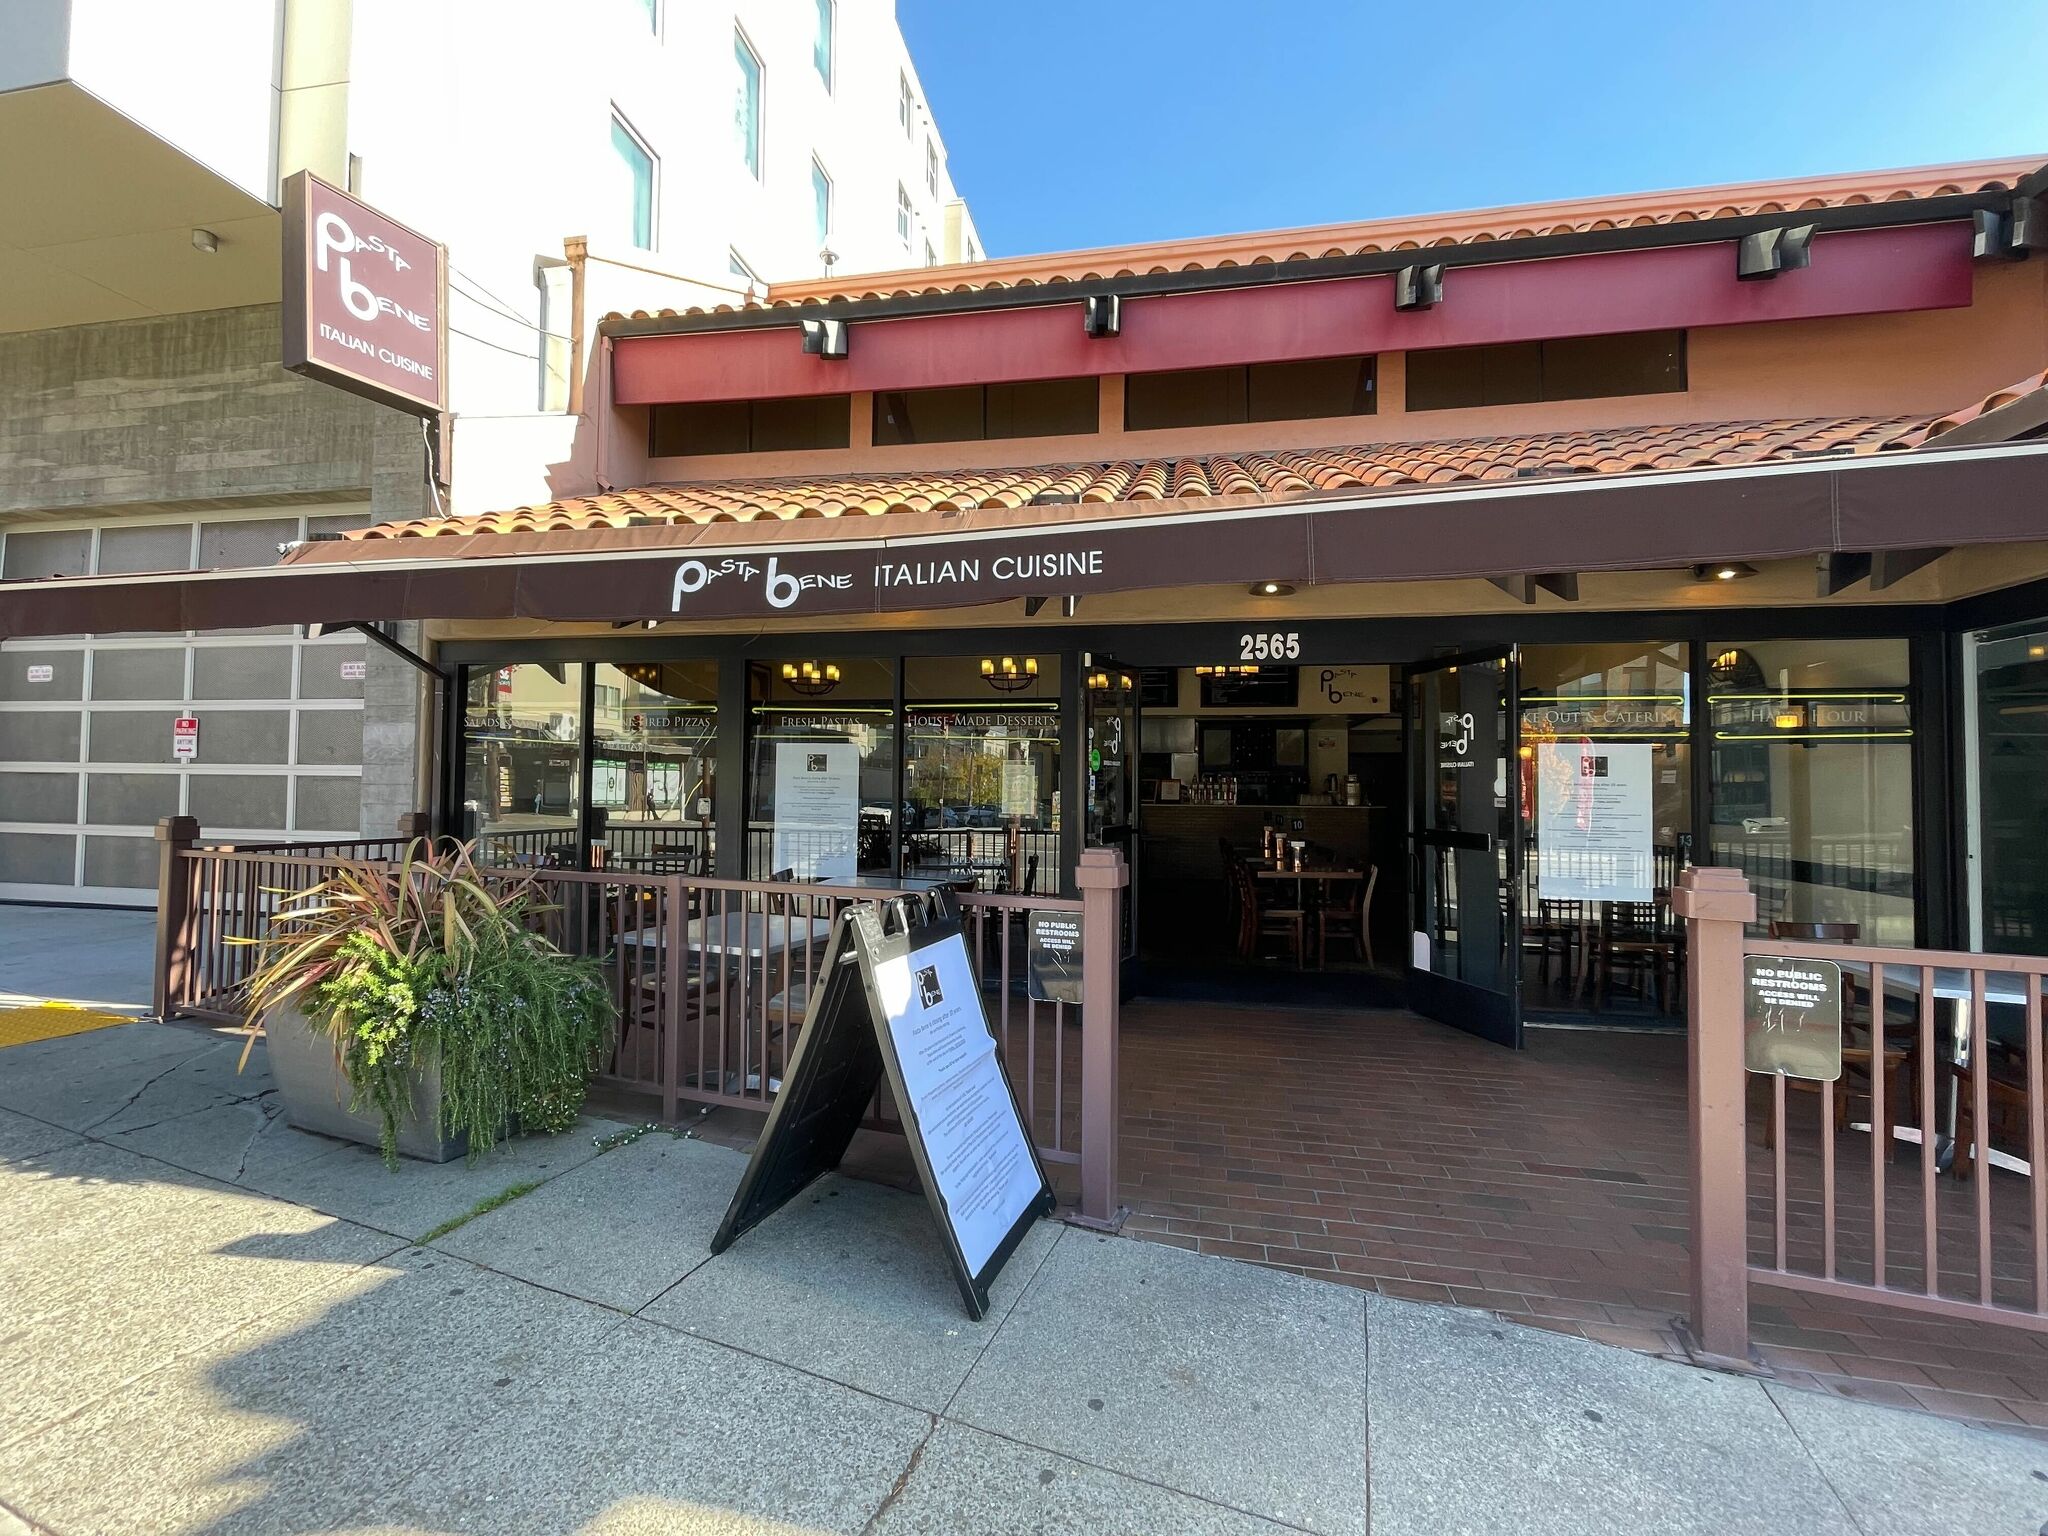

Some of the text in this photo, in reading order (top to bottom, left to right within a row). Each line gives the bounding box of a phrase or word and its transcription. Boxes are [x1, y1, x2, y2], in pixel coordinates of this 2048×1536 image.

[319, 323, 433, 381] ITALIAN CUISINE
[873, 558, 980, 588] ITALIAN
[992, 550, 1104, 580] CUISINE
[1240, 632, 1300, 660] 2565
[463, 717, 500, 728] SALADS
[674, 716, 711, 728] PIZZAS
[781, 716, 860, 727] FRESH PASTAS
[907, 715, 1056, 727] HOUSE-MADE DESSERTS
[1545, 711, 1581, 723] OUT
[1586, 711, 1597, 723] &
[1293, 820, 1303, 830] 10
[1680, 834, 1693, 847] 13
[1035, 929, 1079, 937] RESTROOMS
[1756, 968, 1822, 981] NO PUBLIC
[1751, 978, 1827, 992] RESTROOMS
[1758, 990, 1820, 1001] ACCESS WILL
[1764, 997, 1814, 1008] BE DENIED
